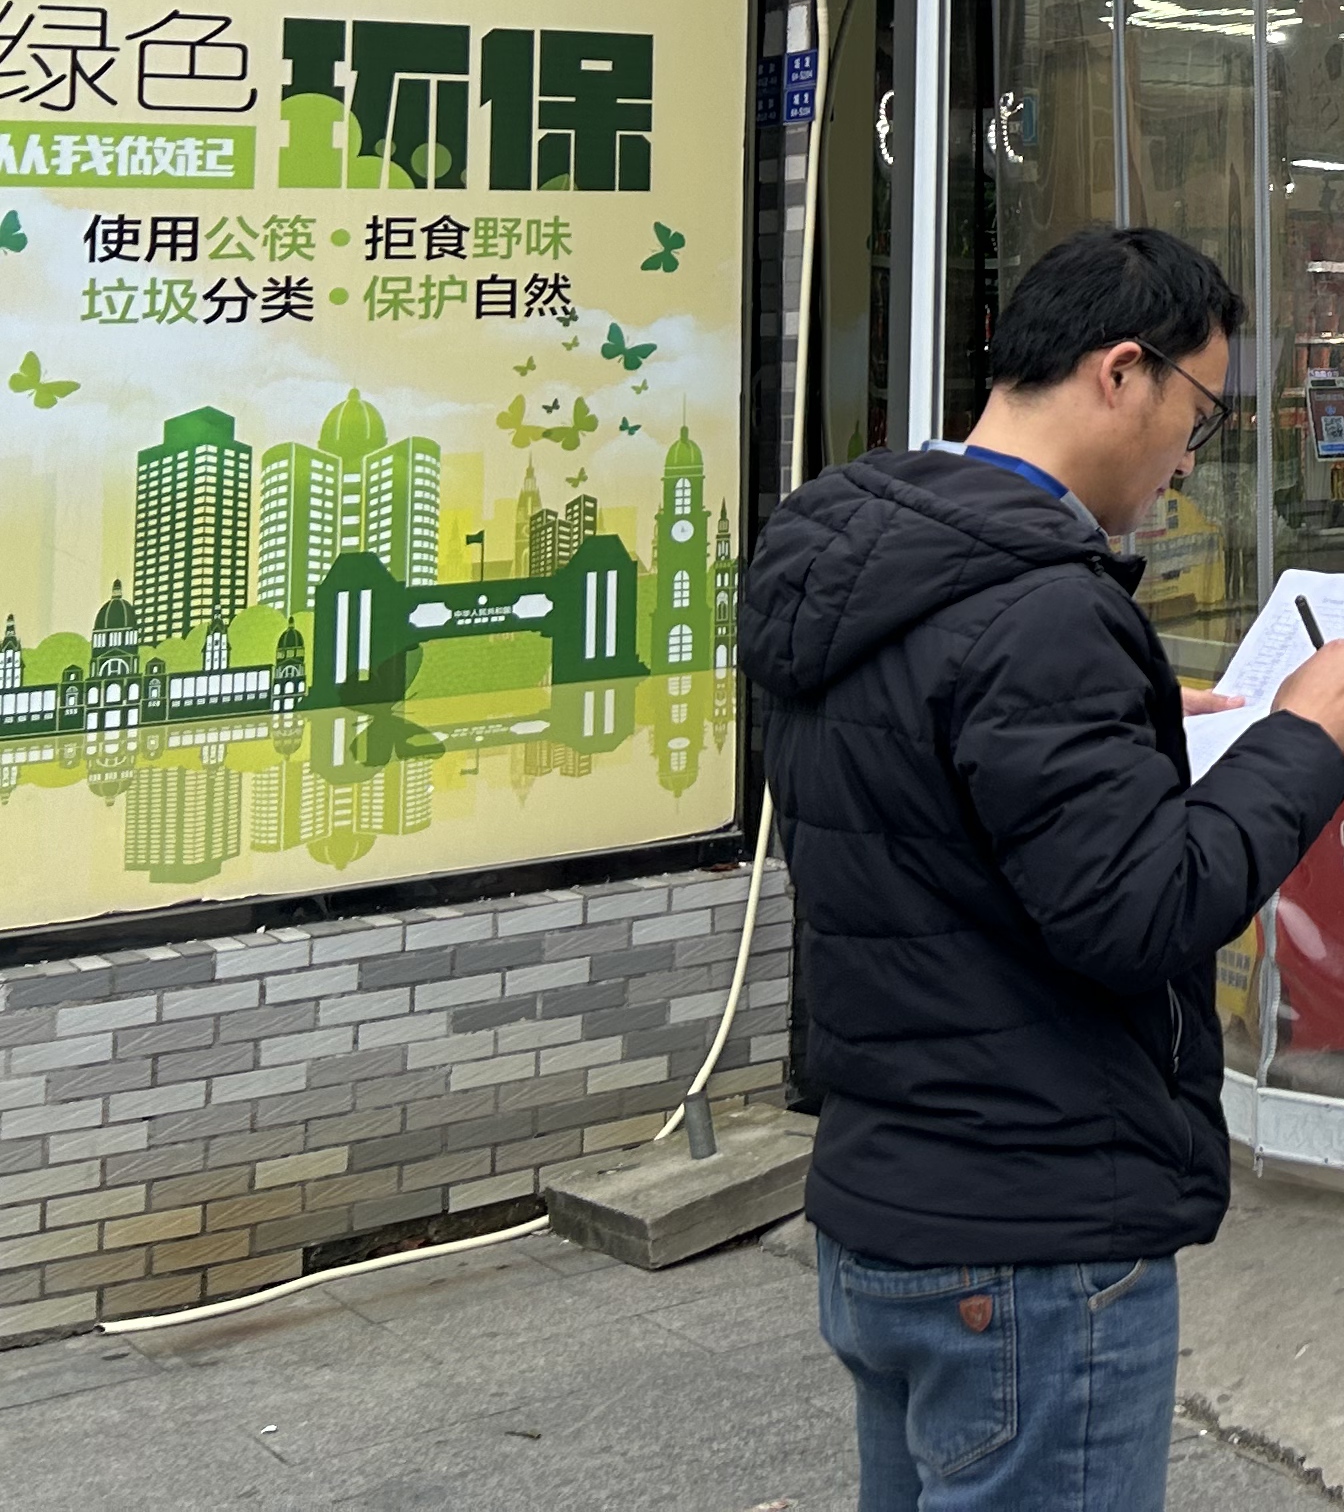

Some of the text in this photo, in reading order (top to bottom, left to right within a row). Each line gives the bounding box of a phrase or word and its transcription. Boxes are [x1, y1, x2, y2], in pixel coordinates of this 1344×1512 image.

[0, 0, 655, 191] 绿色 环保
[0, 134, 236, 178] 从我做起
